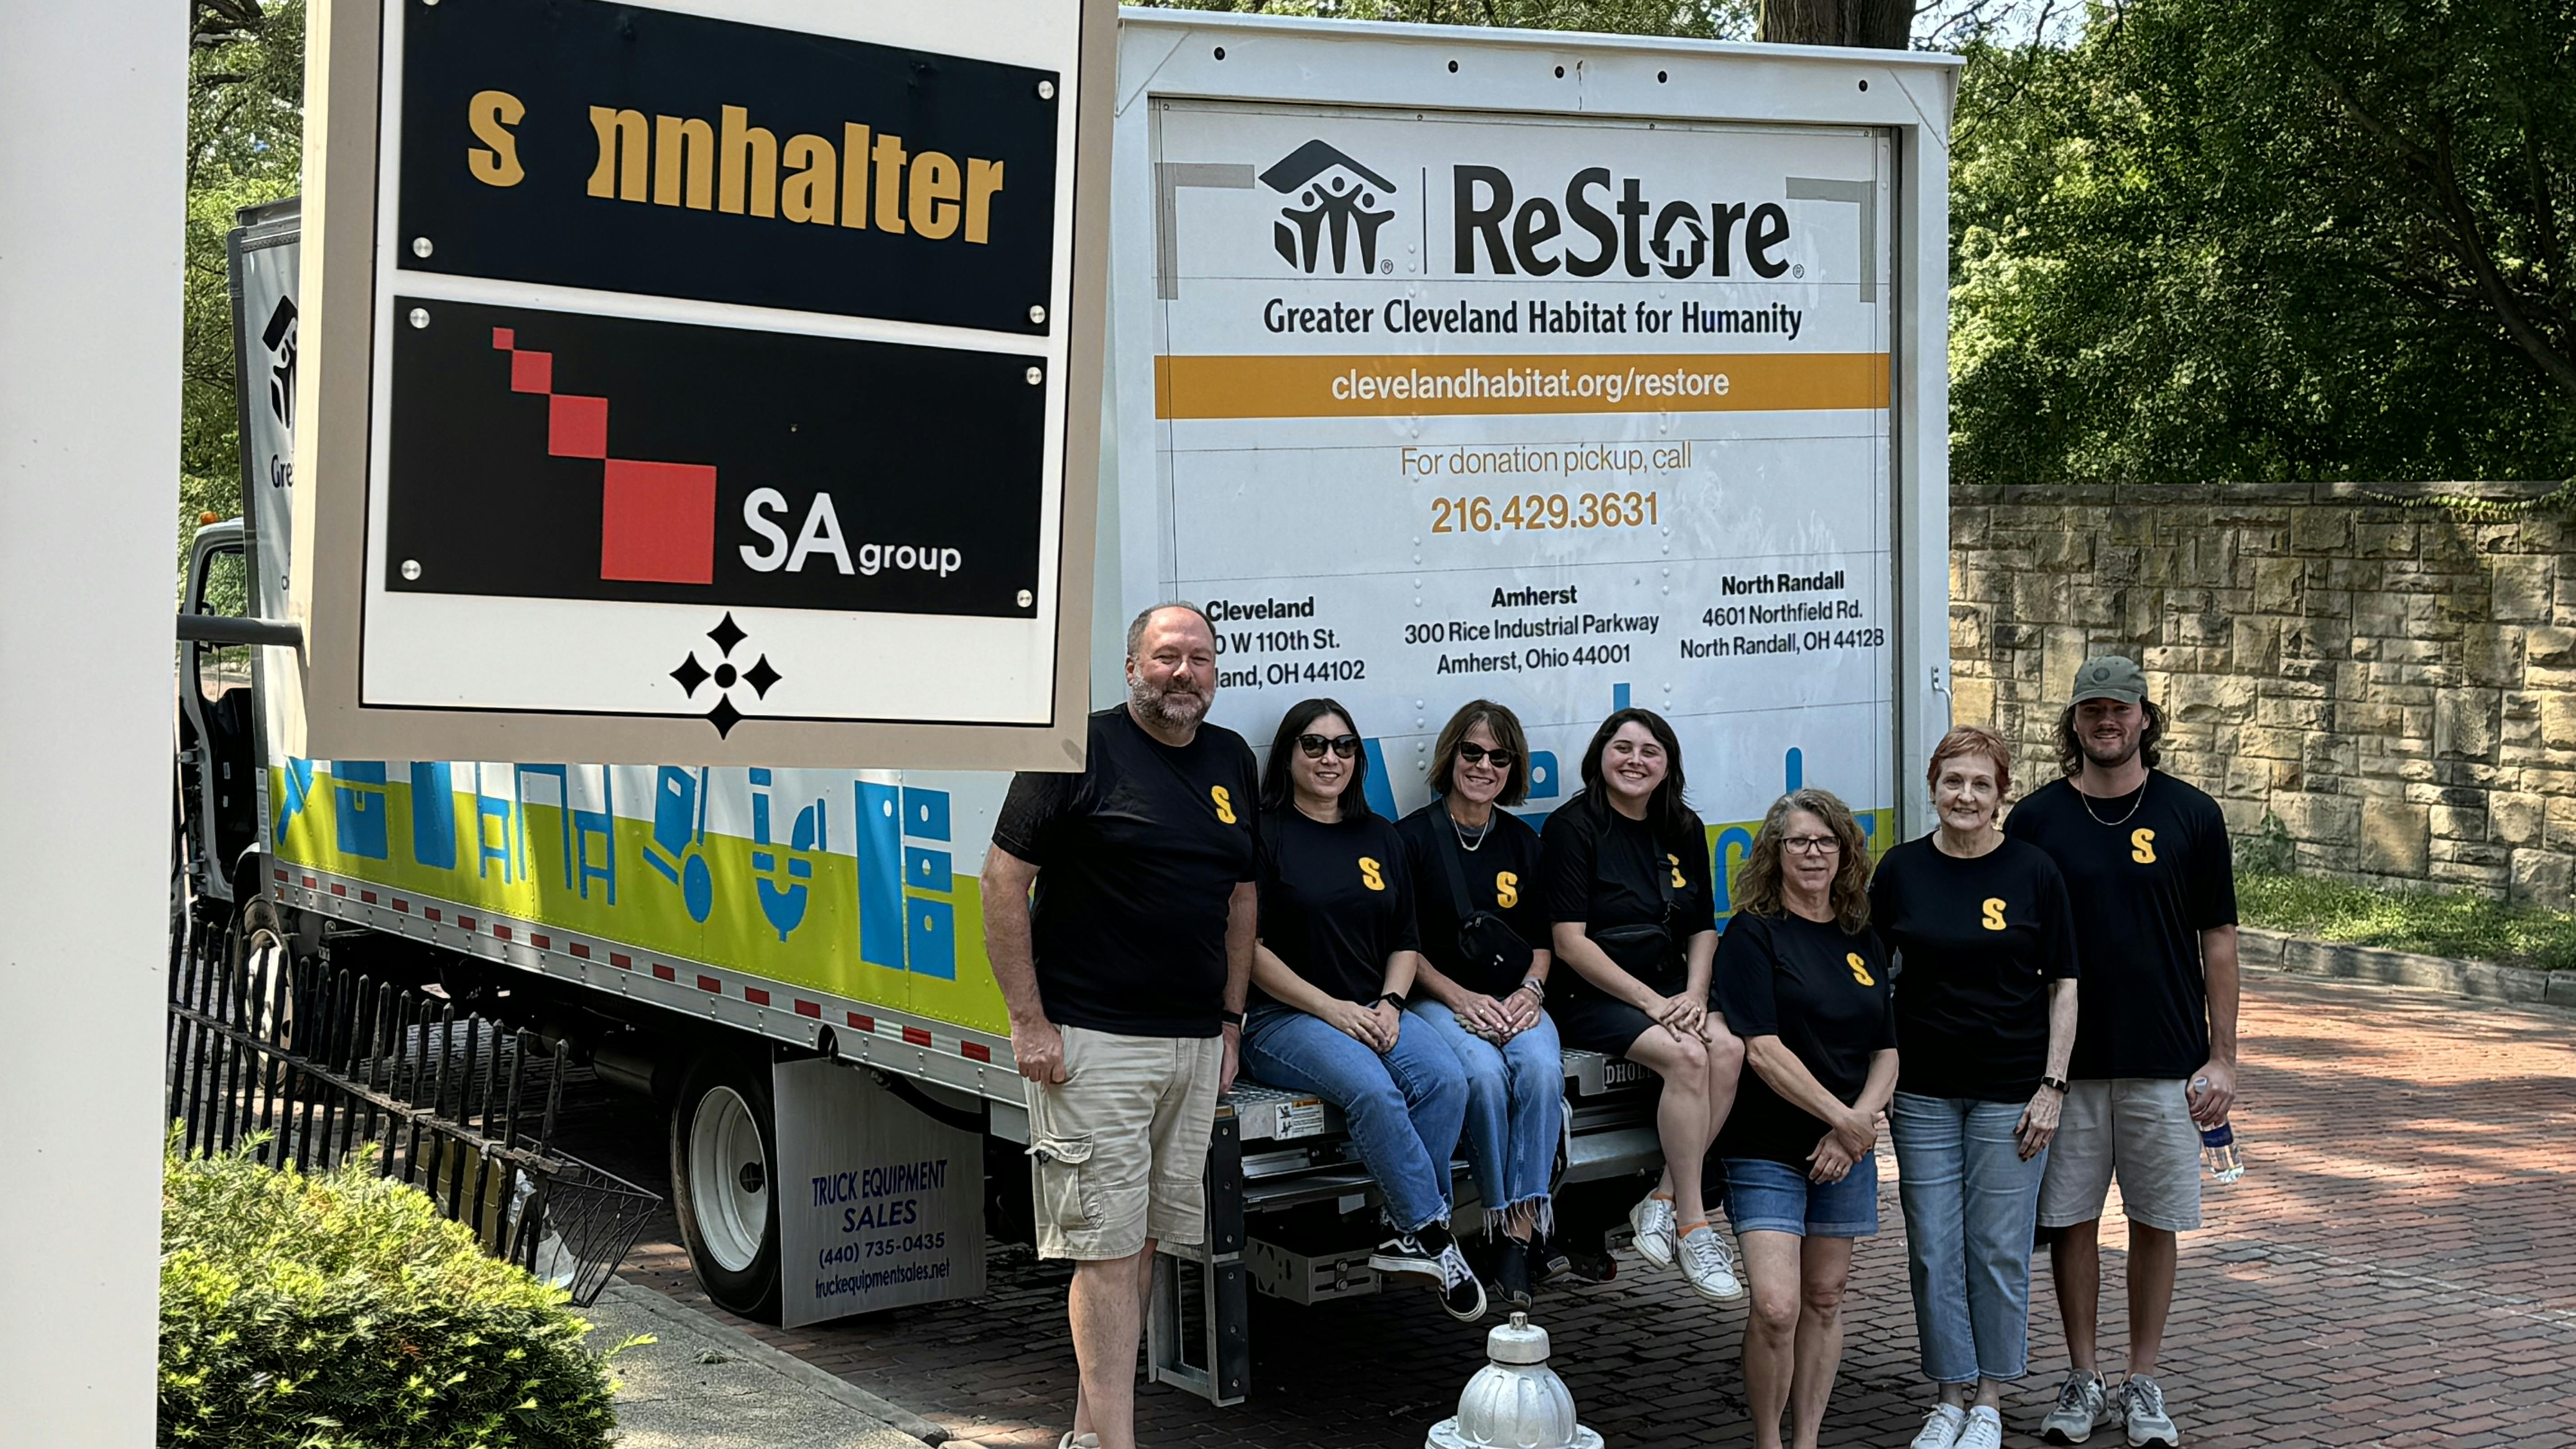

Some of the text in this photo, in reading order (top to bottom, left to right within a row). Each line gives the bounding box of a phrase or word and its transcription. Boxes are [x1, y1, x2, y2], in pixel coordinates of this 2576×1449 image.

[1264, 298, 1802, 341] Greater Cleveland Habitat for Humanity
[1332, 367, 1730, 403] clevelandhabitat.org/restore
[271, 454, 294, 488] Gre
[1401, 441, 1692, 478] For donation pickup, call
[1431, 491, 1657, 534] 216.429.3631
[739, 487, 962, 578] SA group
[1491, 585, 1578, 607] Amherst
[1721, 570, 1844, 596] North Randall
[1205, 596, 1314, 621] Cleveland
[1702, 599, 1863, 627] 4601 Northfield Rd.
[1215, 628, 1340, 655] 0 W 110th St.
[1404, 613, 1659, 644] 300 Rice Industrial Parkway
[1680, 628, 1885, 658] North Randall, OH 44128
[1216, 659, 1365, 690] land, OH 44102
[1437, 644, 1630, 675] Amherst, Ohio 44001
[1211, 785, 1237, 824] S
[2131, 828, 2157, 864] S
[1358, 857, 1385, 891] S
[1496, 871, 1518, 909] S
[1982, 897, 2007, 930] S
[1847, 952, 1874, 986] S
[1605, 1063, 1655, 1084] DHOLL
[812, 1159, 947, 1207] TRUCK EQUIPMENT
[842, 1199, 917, 1233] SALES
[819, 1232, 945, 1269] (440) 735-0435
[815, 1257, 950, 1299] truckequipmentsales.net
